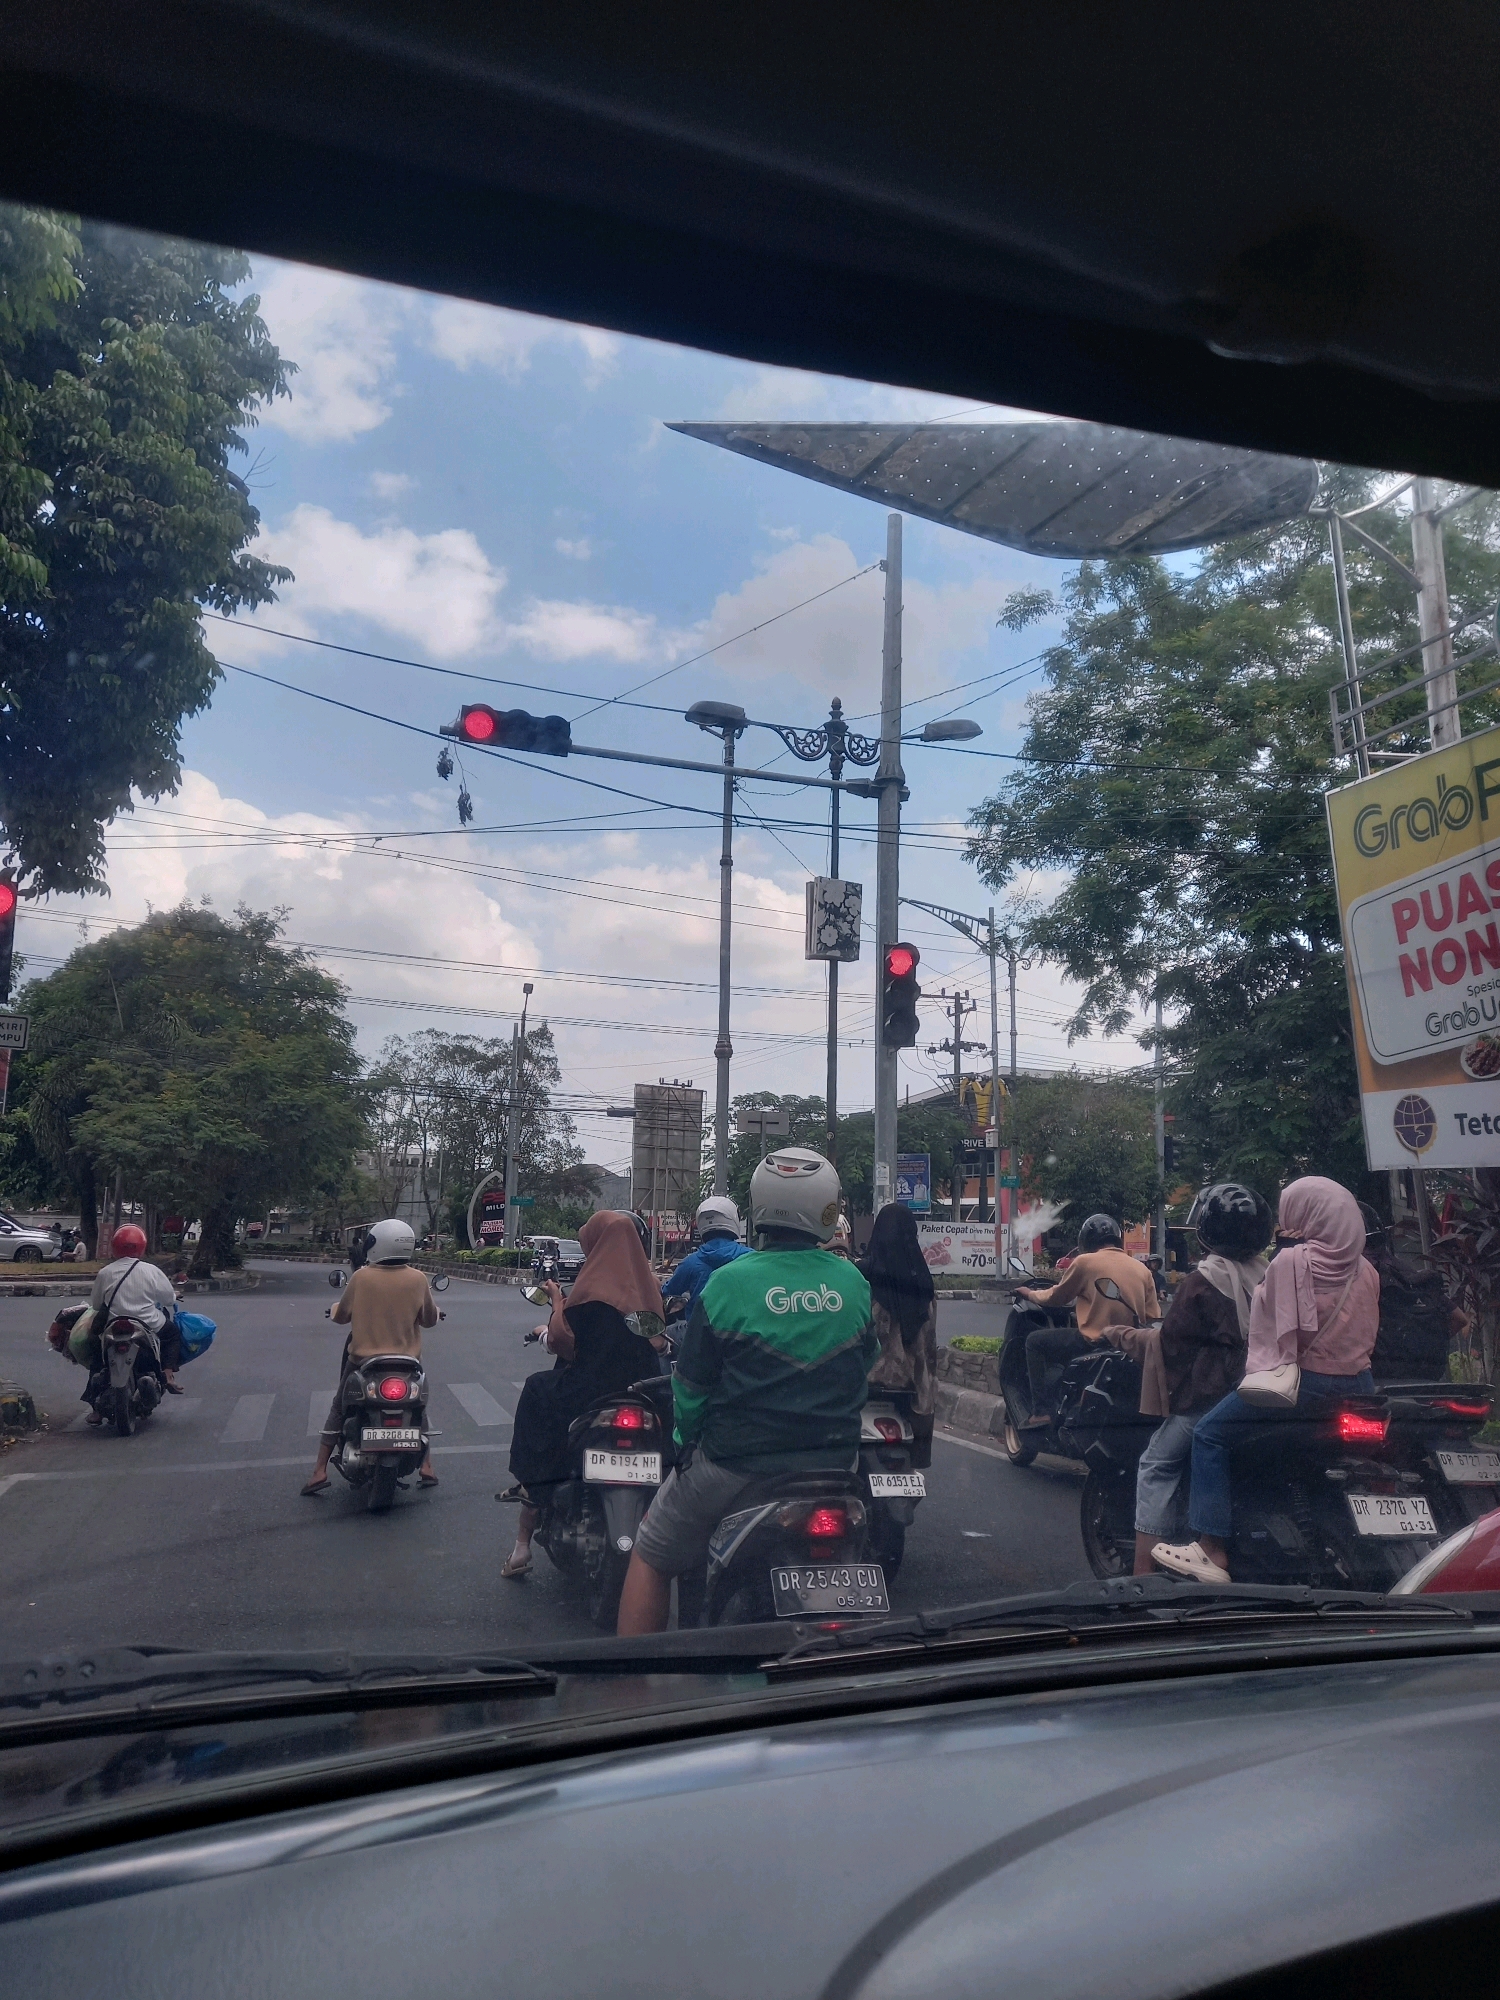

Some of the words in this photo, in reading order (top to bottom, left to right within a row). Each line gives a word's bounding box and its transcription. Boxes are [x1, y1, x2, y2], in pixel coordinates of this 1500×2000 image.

[961, 1139, 985, 1148] RIVE
[921, 1224, 944, 1234] Paket
[945, 1225, 969, 1236] Cepat
[765, 1283, 843, 1314] Grab
[366, 1431, 377, 1439] DR
[591, 1453, 606, 1465] DR
[610, 1456, 638, 1467] 6194
[642, 1456, 657, 1468] NH
[871, 1475, 884, 1487] DR
[886, 1476, 909, 1487] 6151
[1352, 1499, 1370, 1516] DR
[1410, 1500, 1428, 1515] YZ
[779, 1571, 801, 1591] DR
[805, 1569, 851, 1589] 2543
[857, 1569, 878, 1588] CU
